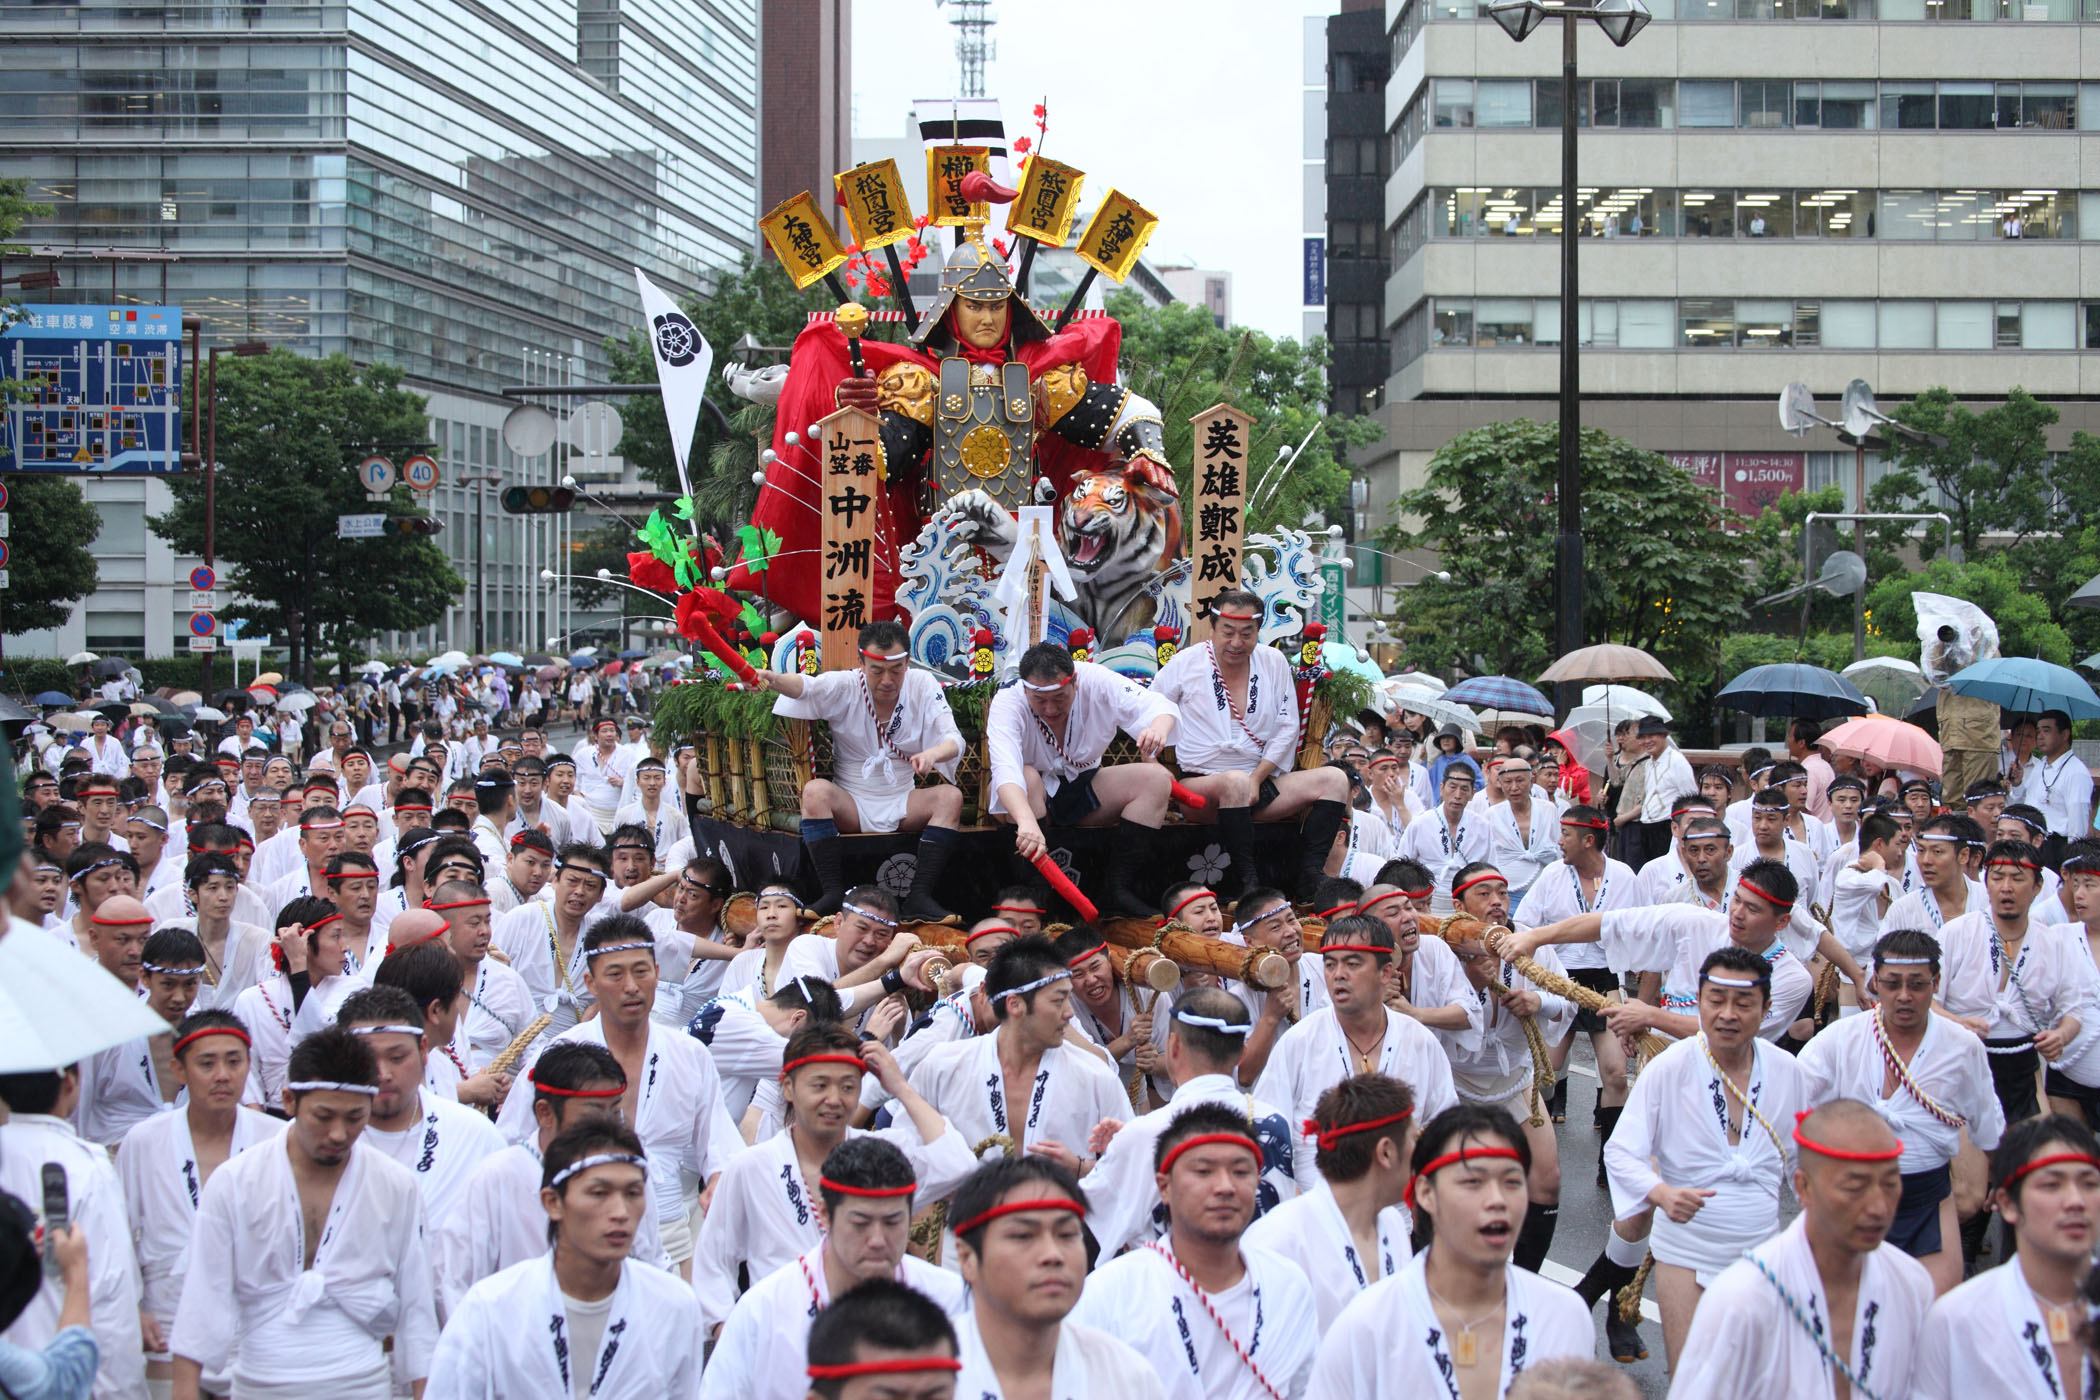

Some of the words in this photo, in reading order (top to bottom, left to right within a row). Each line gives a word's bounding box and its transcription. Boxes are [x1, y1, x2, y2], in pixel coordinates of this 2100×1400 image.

[783, 214, 823, 268] 大神宮
[1097, 209, 1135, 264] 大神宮
[29, 314, 94, 329] 駐車誘導
[109, 324, 120, 335] 空
[126, 324, 137, 335] 満
[145, 324, 167, 335] 渋滞
[67, 395, 80, 405] 天神
[828, 431, 851, 476] 山笠
[852, 440, 876, 477] 一番
[412, 465, 432, 481] 40
[826, 486, 872, 632] 中洲流
